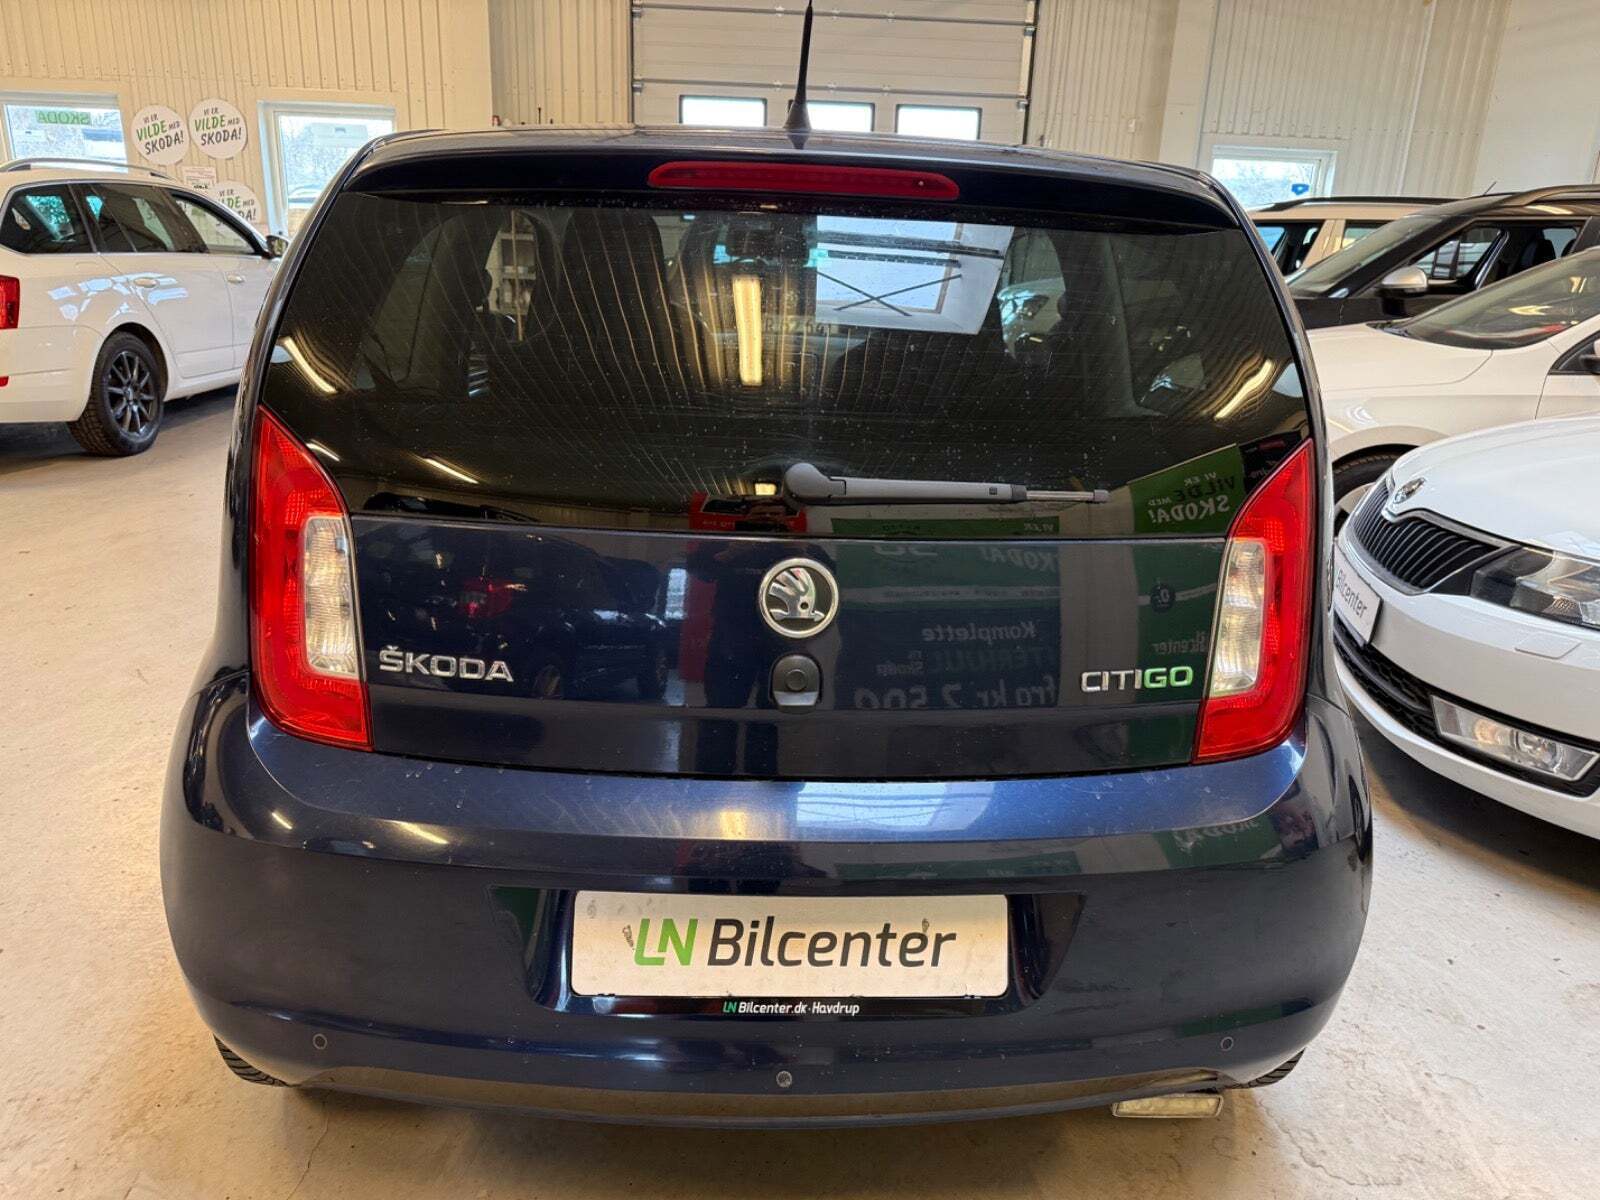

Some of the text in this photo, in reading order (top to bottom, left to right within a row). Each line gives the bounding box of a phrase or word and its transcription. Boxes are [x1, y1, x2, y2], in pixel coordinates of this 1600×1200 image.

[136, 120, 180, 142] VILDE MED
[194, 114, 240, 132] VILDE MED
[144, 130, 184, 155] SKODA!
[200, 127, 242, 146] SKODA!
[379, 644, 514, 683] ŠKODA
[1081, 665, 1194, 692] CITIGO
[634, 915, 957, 967] LN Bilcenter
[722, 1001, 738, 1014] LN
[812, 1001, 860, 1017] Havdrup
